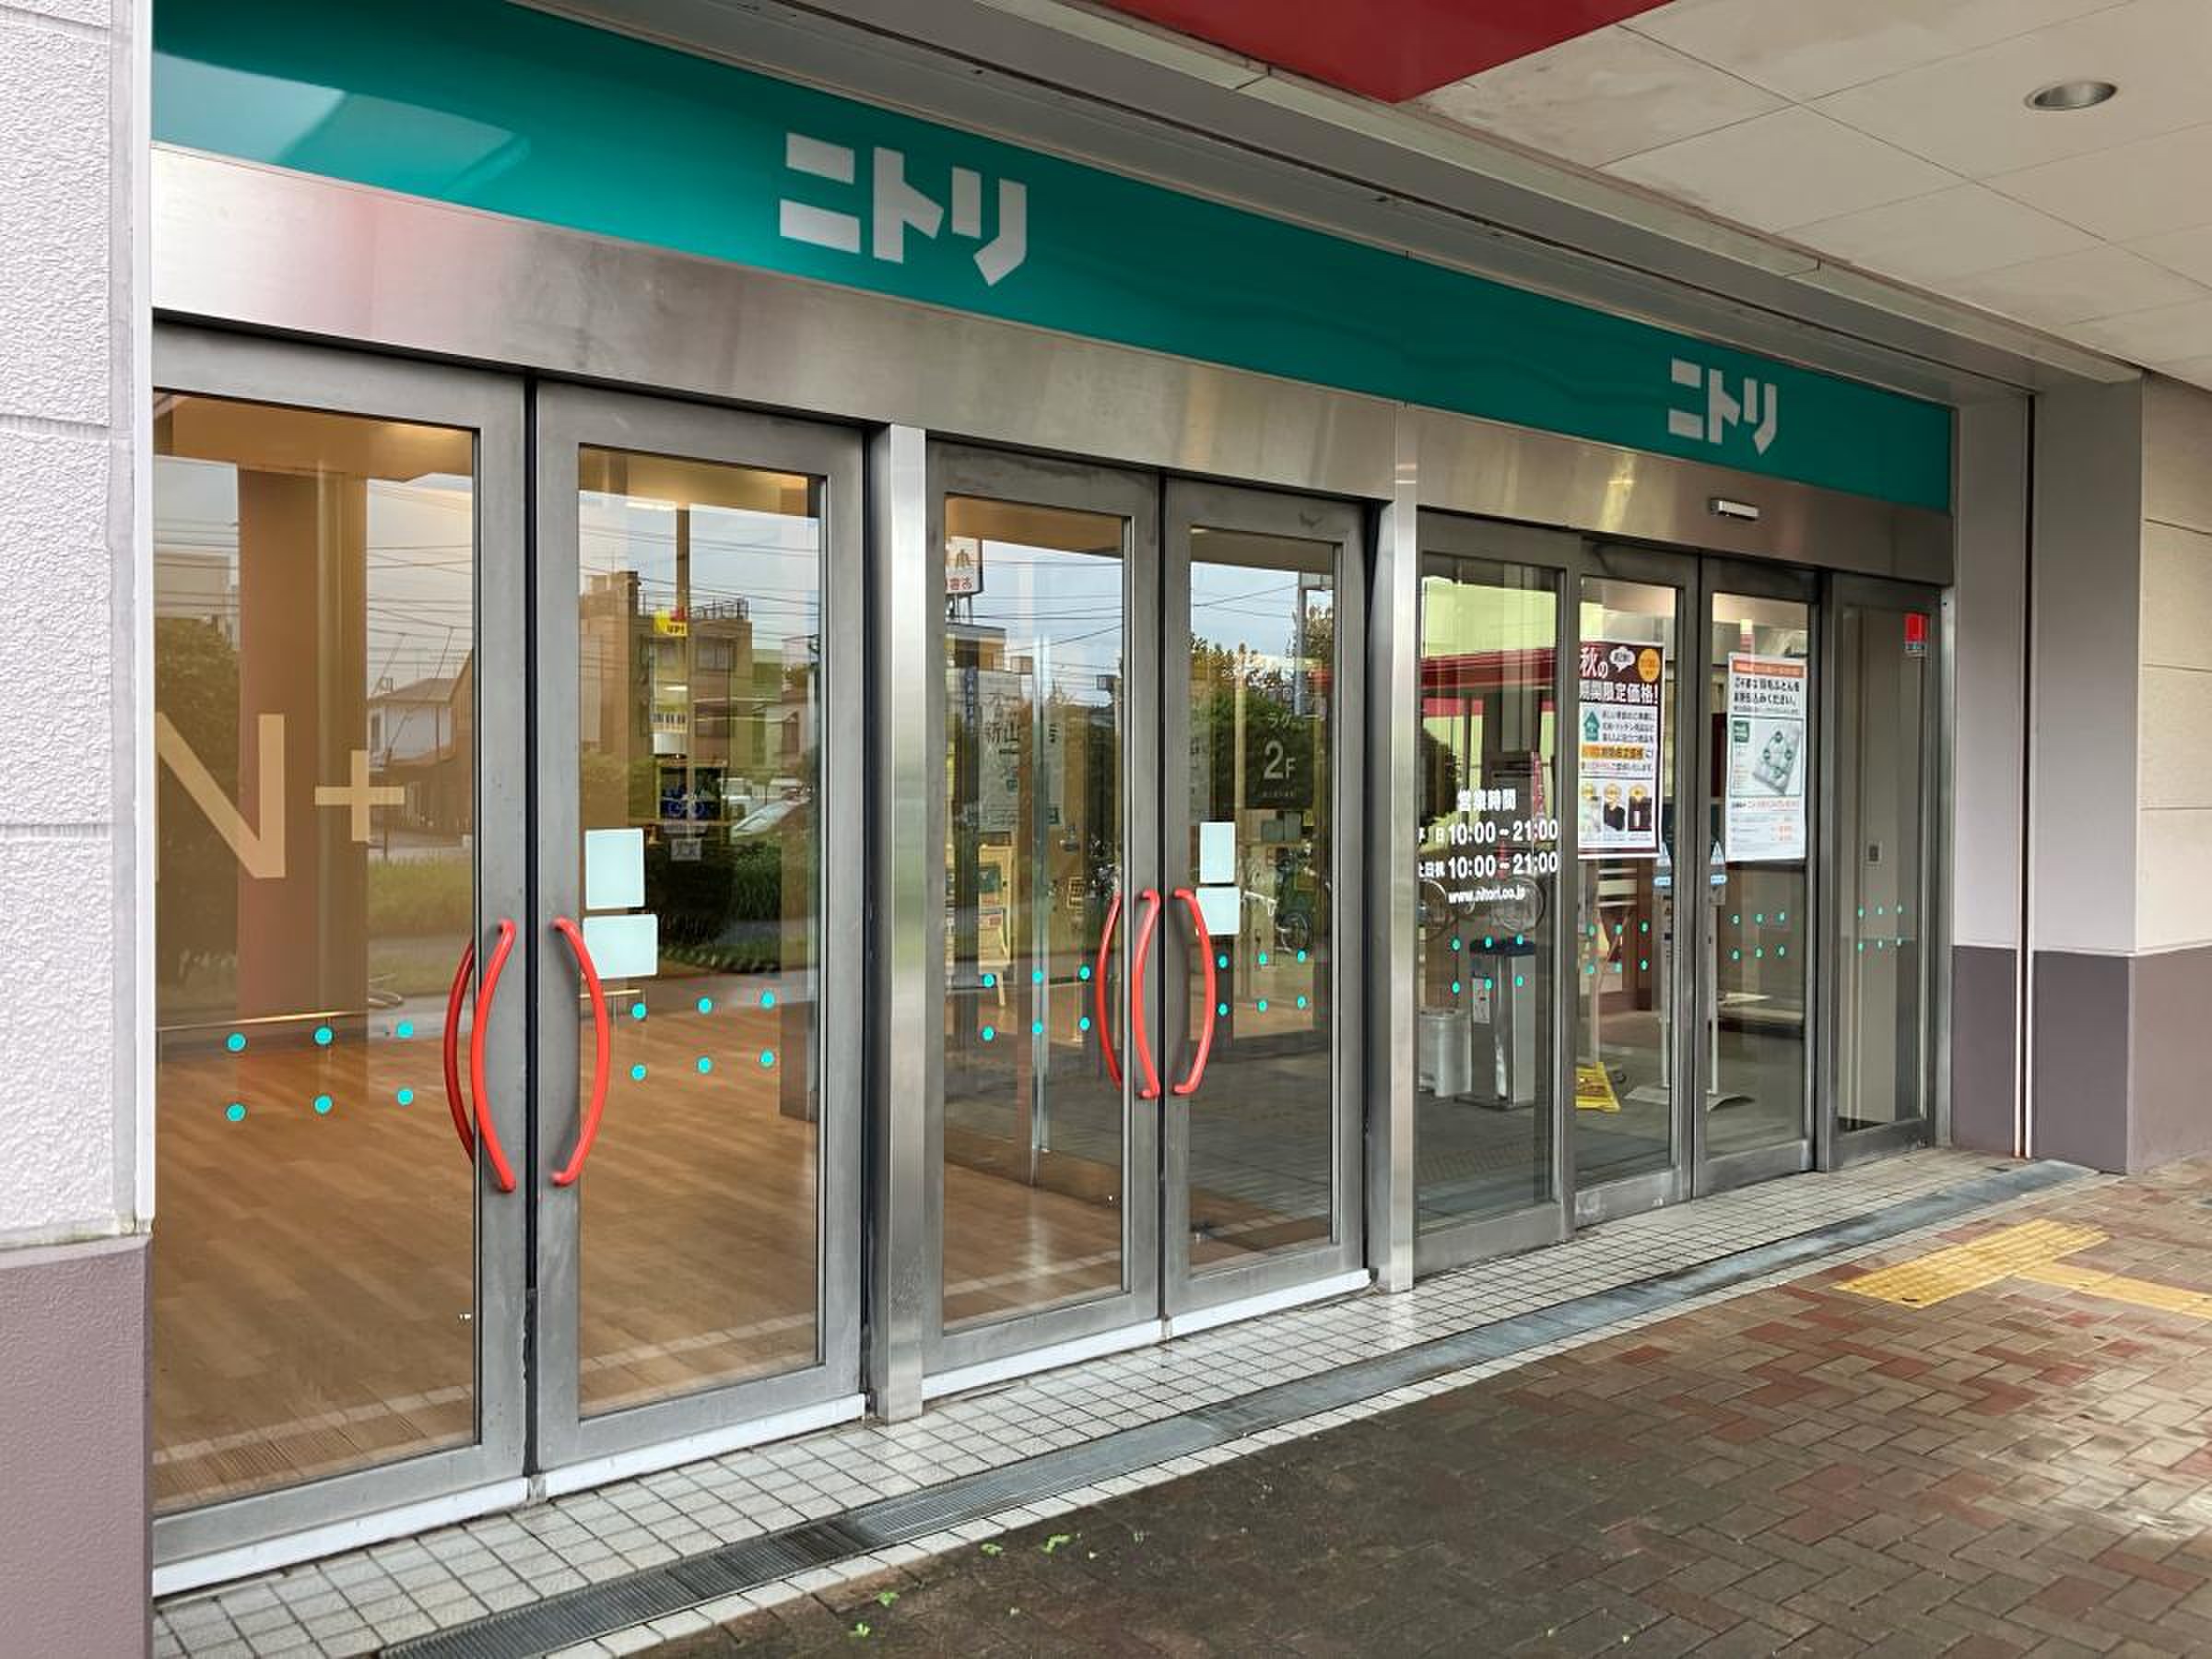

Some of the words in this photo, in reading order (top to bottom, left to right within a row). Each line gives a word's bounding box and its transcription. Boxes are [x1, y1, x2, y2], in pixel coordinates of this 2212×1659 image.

[780, 131, 1028, 288] ニトリ
[1667, 356, 1778, 457] ニトリ
[1457, 788, 1517, 812] 営業時間
